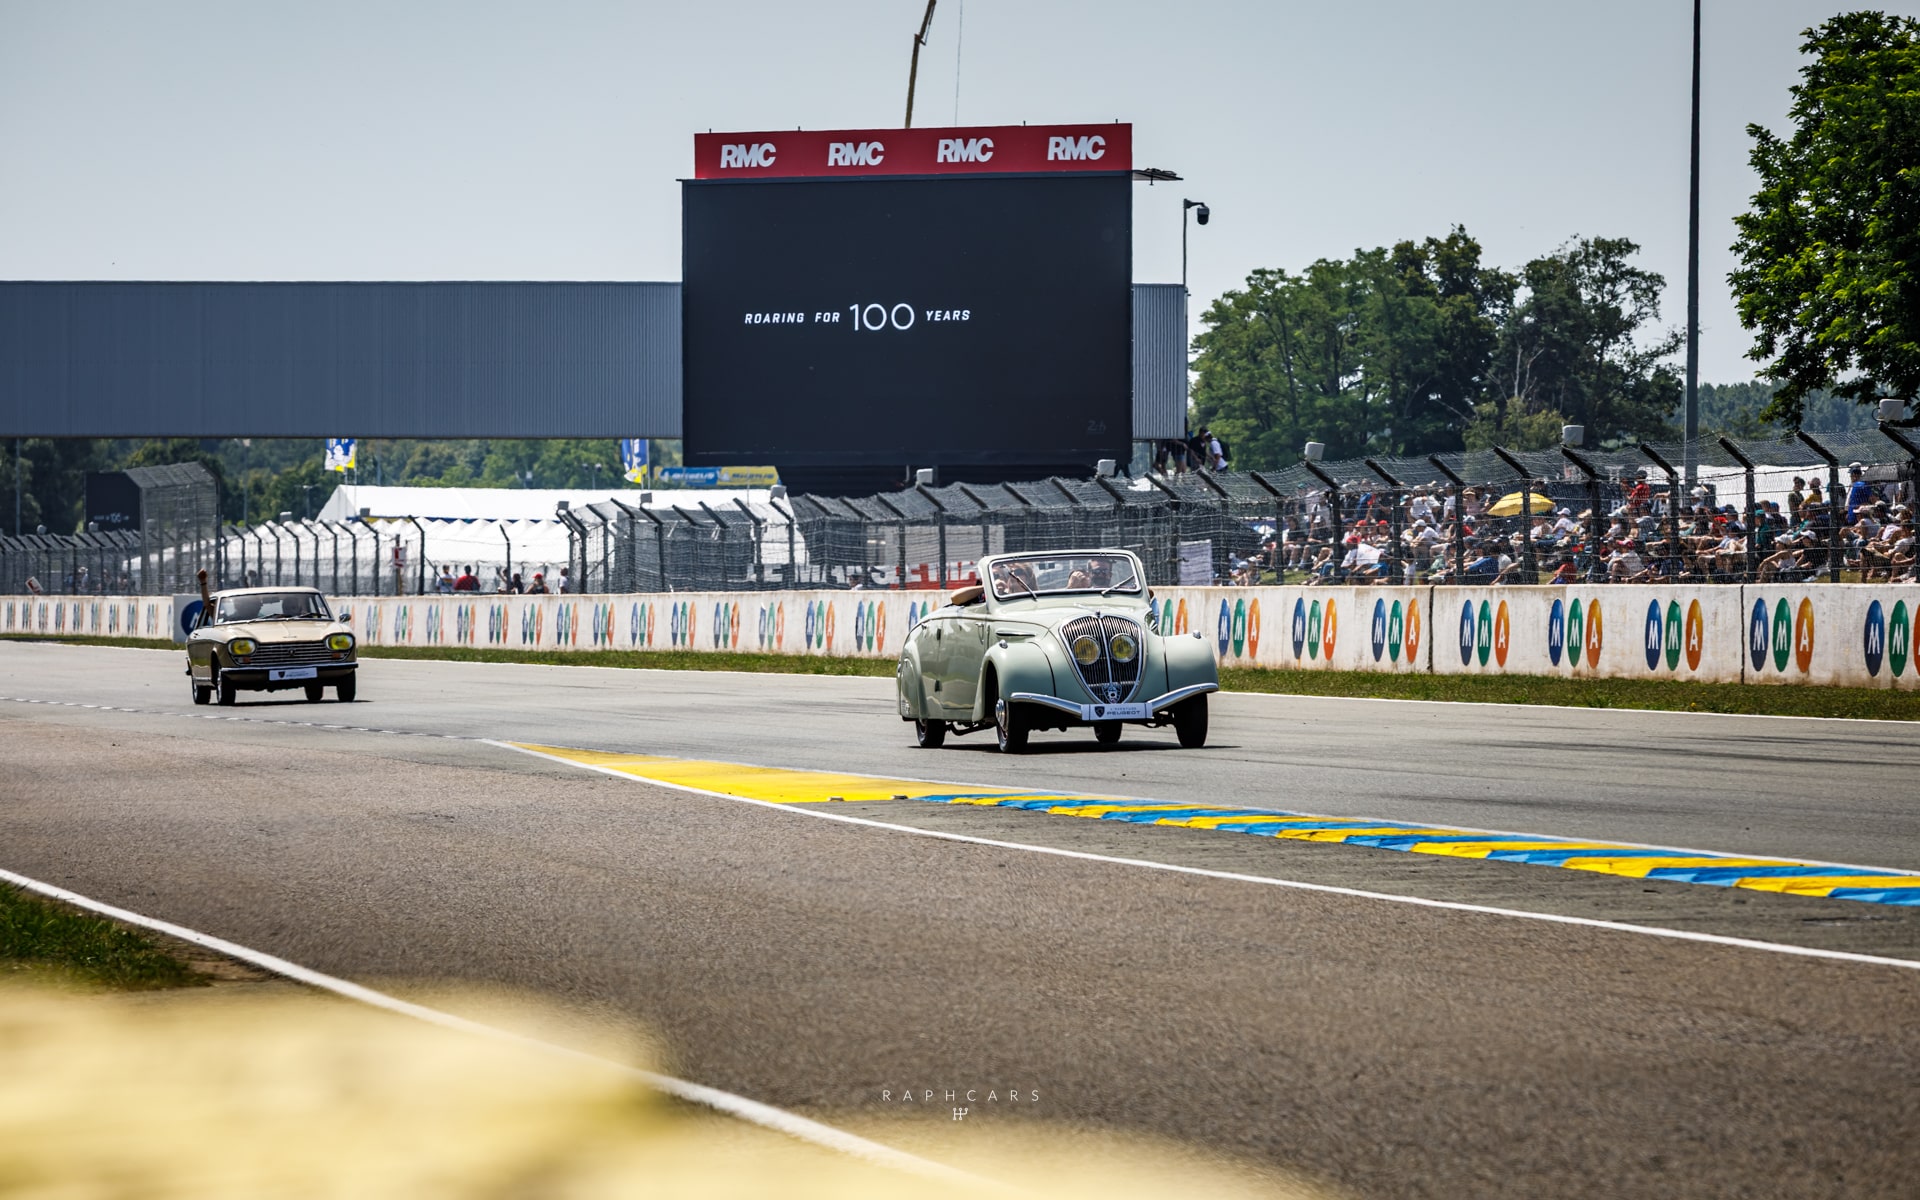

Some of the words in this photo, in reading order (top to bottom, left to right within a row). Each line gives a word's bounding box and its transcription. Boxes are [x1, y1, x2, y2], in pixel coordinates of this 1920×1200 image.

[720, 143, 776, 168] RMC
[827, 141, 885, 167] RMC
[937, 137, 994, 163] RMC
[1047, 135, 1106, 161] RMC
[744, 312, 805, 325] ROARING
[814, 311, 841, 324] FOR
[849, 302, 916, 332] 100
[925, 309, 971, 322] YEARS
